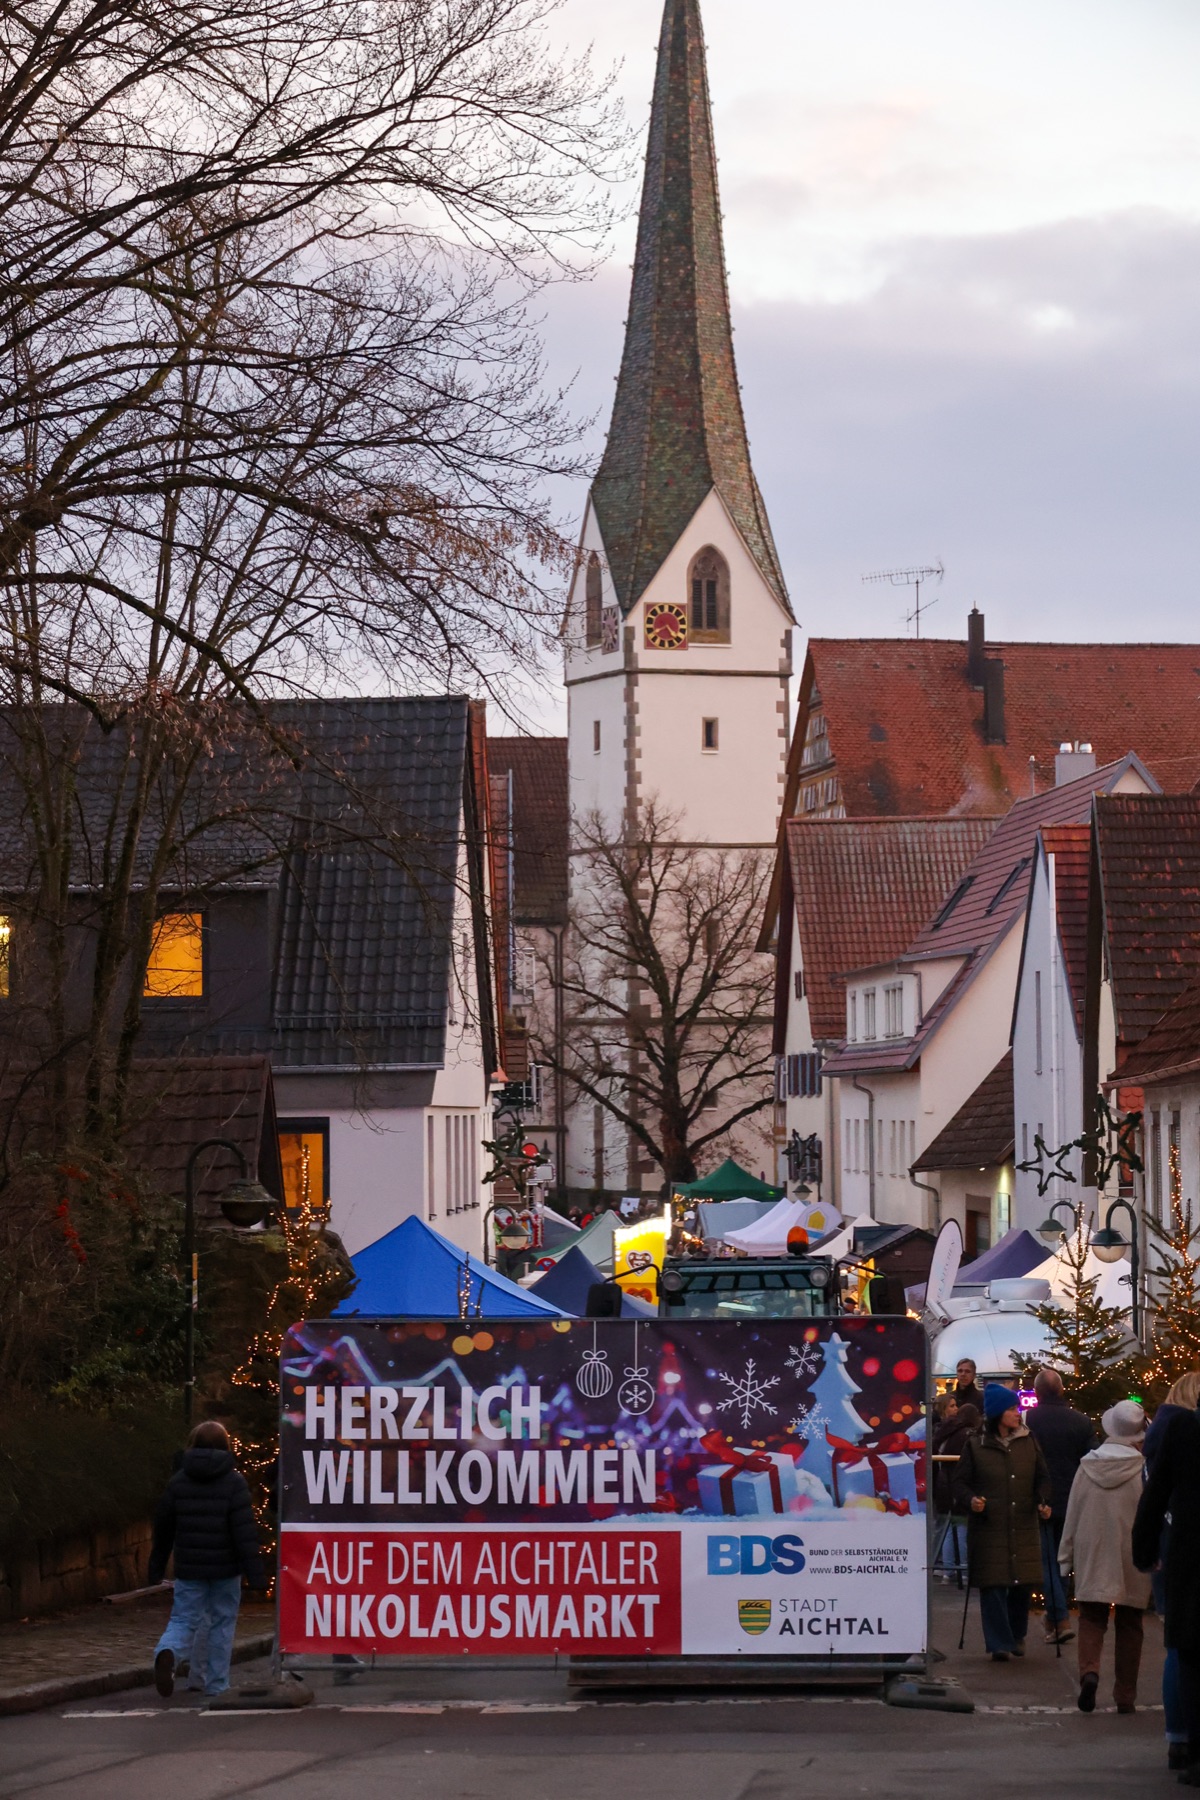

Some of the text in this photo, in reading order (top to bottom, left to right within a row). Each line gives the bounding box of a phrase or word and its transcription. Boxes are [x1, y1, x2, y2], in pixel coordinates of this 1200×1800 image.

[305, 1385, 541, 1441] HERZLICH
[1021, 1396, 1039, 1408] OP
[303, 1449, 656, 1505] WILLKOMMEN
[306, 1541, 659, 1586] AUF DEM AICHTALER
[706, 1534, 806, 1576] BDS
[844, 1547, 909, 1556] SELBSTSTÄNDIGEN
[809, 1564, 909, 1575] www.BDS-AICHTAL.de
[305, 1593, 660, 1639] NIKOLAUSMARKT
[778, 1598, 838, 1613] STADT
[778, 1617, 889, 1636] AICHTAL
